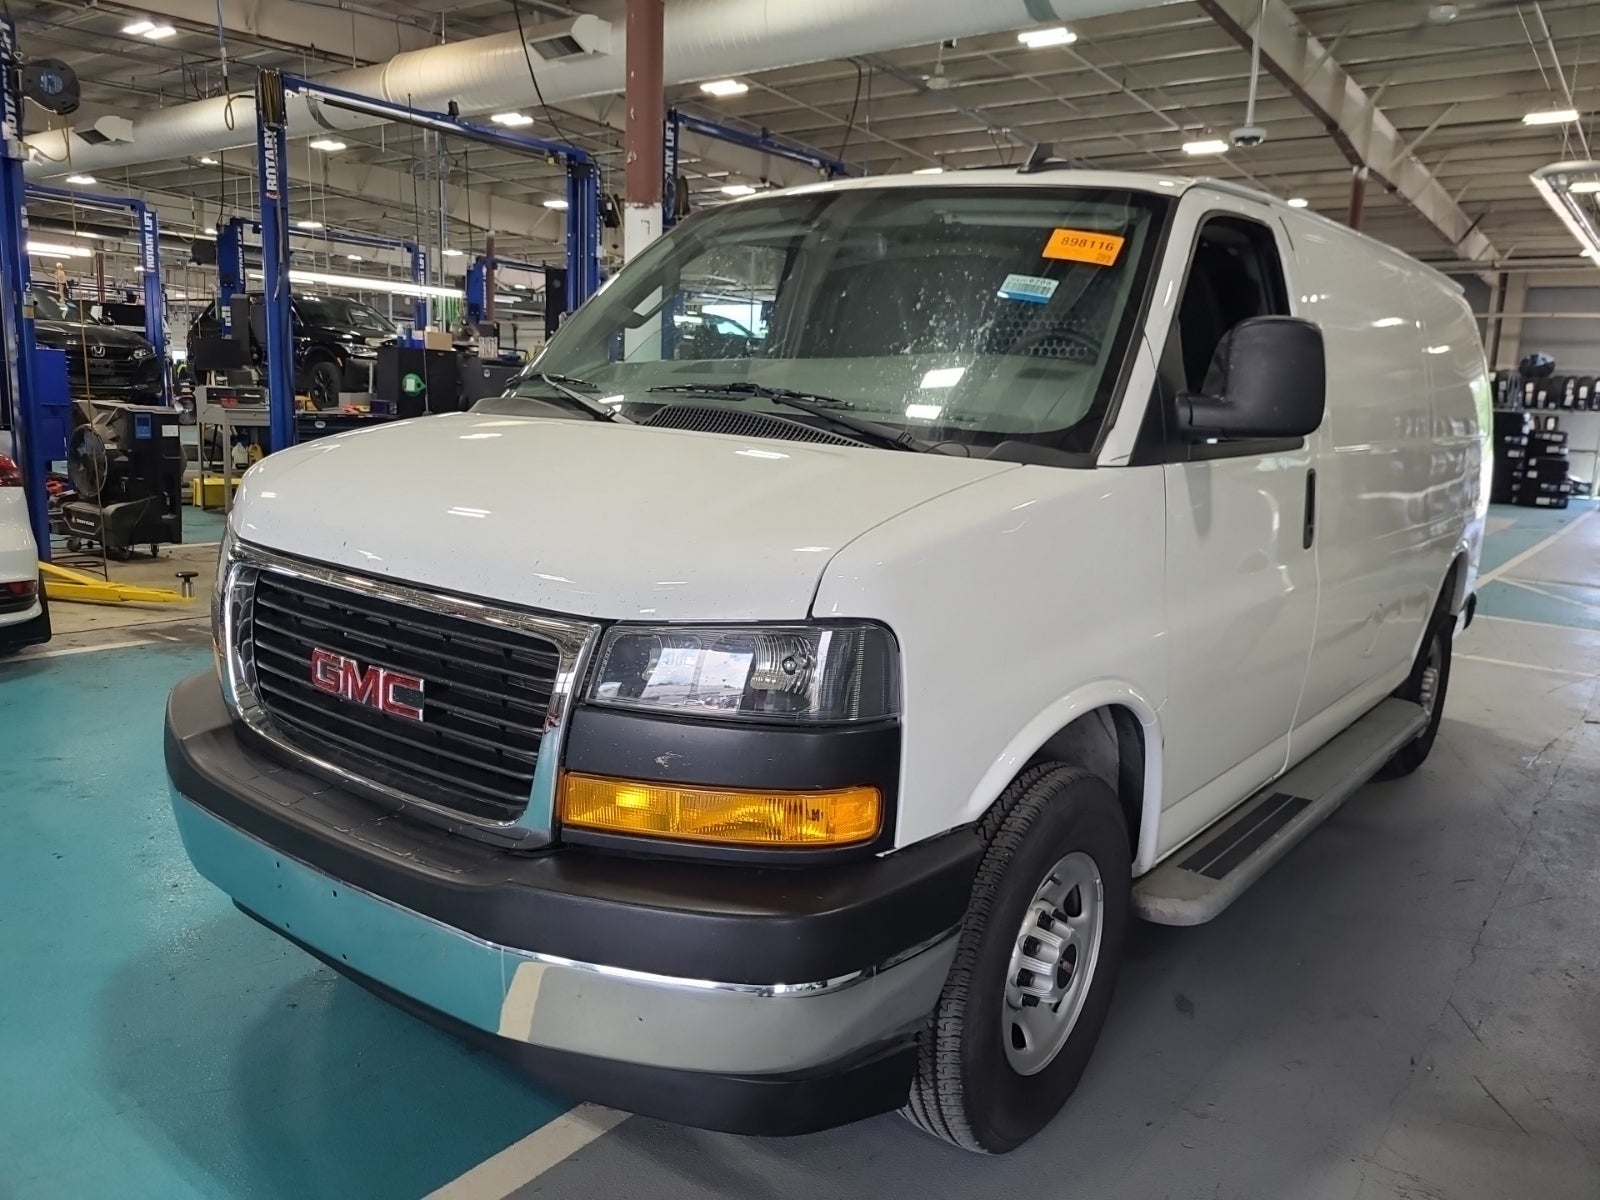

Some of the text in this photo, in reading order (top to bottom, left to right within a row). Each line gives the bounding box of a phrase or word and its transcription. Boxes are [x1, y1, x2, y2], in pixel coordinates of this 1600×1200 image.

[664, 121, 675, 147] LIFT
[264, 126, 279, 191] ROTARY
[144, 211, 155, 268] ROTARY LIFT
[1061, 236, 1115, 252] 898116
[25, 282, 31, 292] 2
[311, 647, 424, 722] GMC
